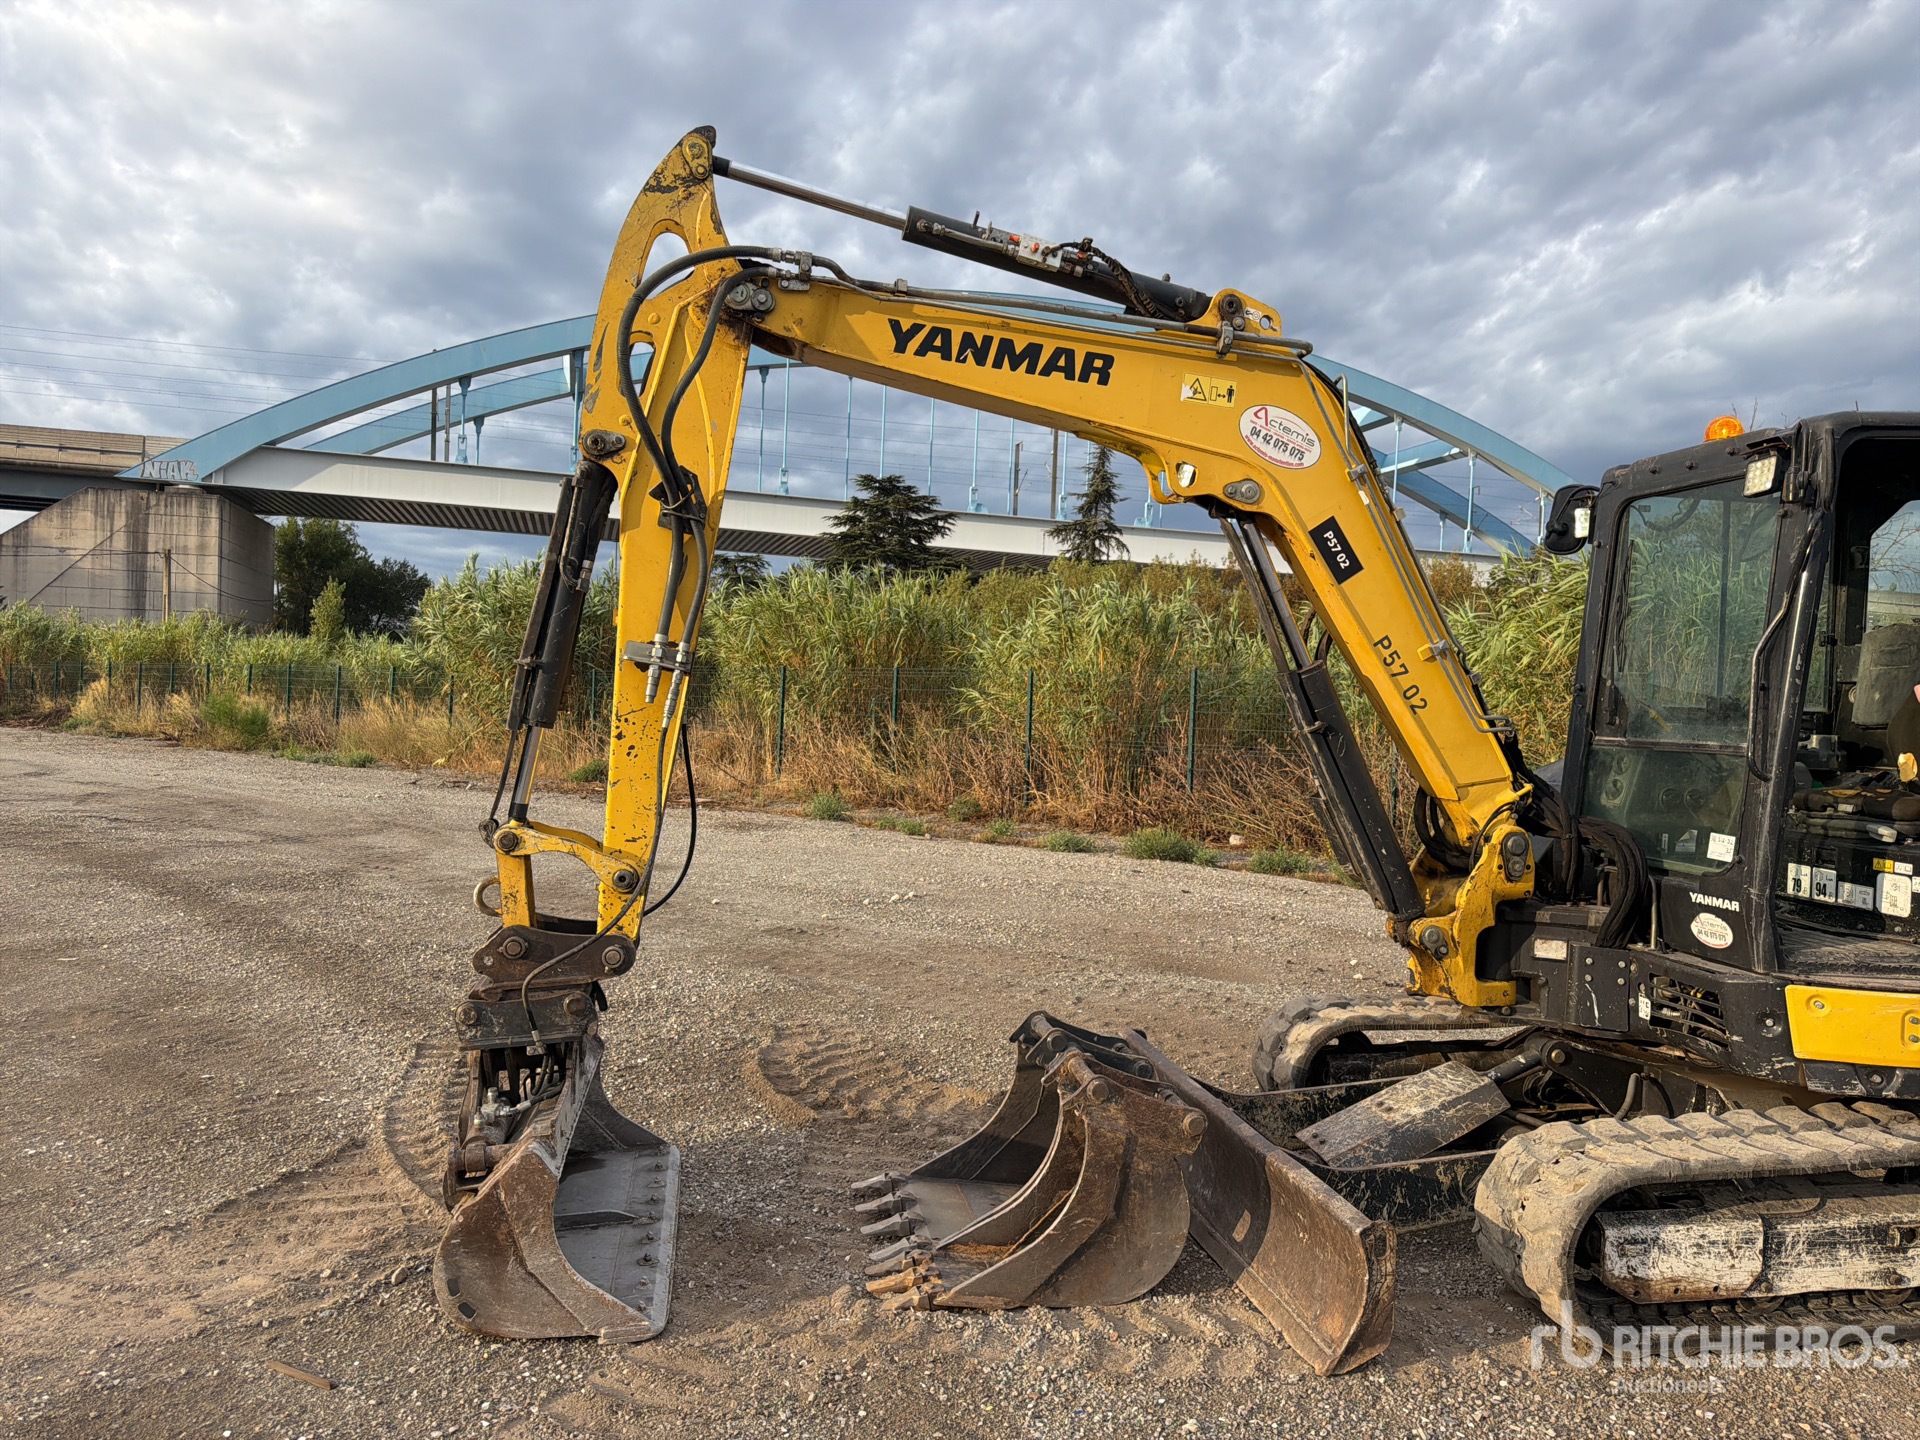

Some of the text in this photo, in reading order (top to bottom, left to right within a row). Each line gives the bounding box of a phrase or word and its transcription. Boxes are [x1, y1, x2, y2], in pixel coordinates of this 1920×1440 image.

[888, 318, 1115, 386] YANMAR
[1250, 426, 1305, 461] 04 42 075 075
[1253, 407, 1315, 447] Actemis
[1323, 530, 1350, 569] P57 02
[1372, 634, 1428, 716] P57 02
[1689, 891, 1740, 912] YANMAR
[1792, 878, 1801, 893] 79
[1816, 882, 1827, 898] 94
